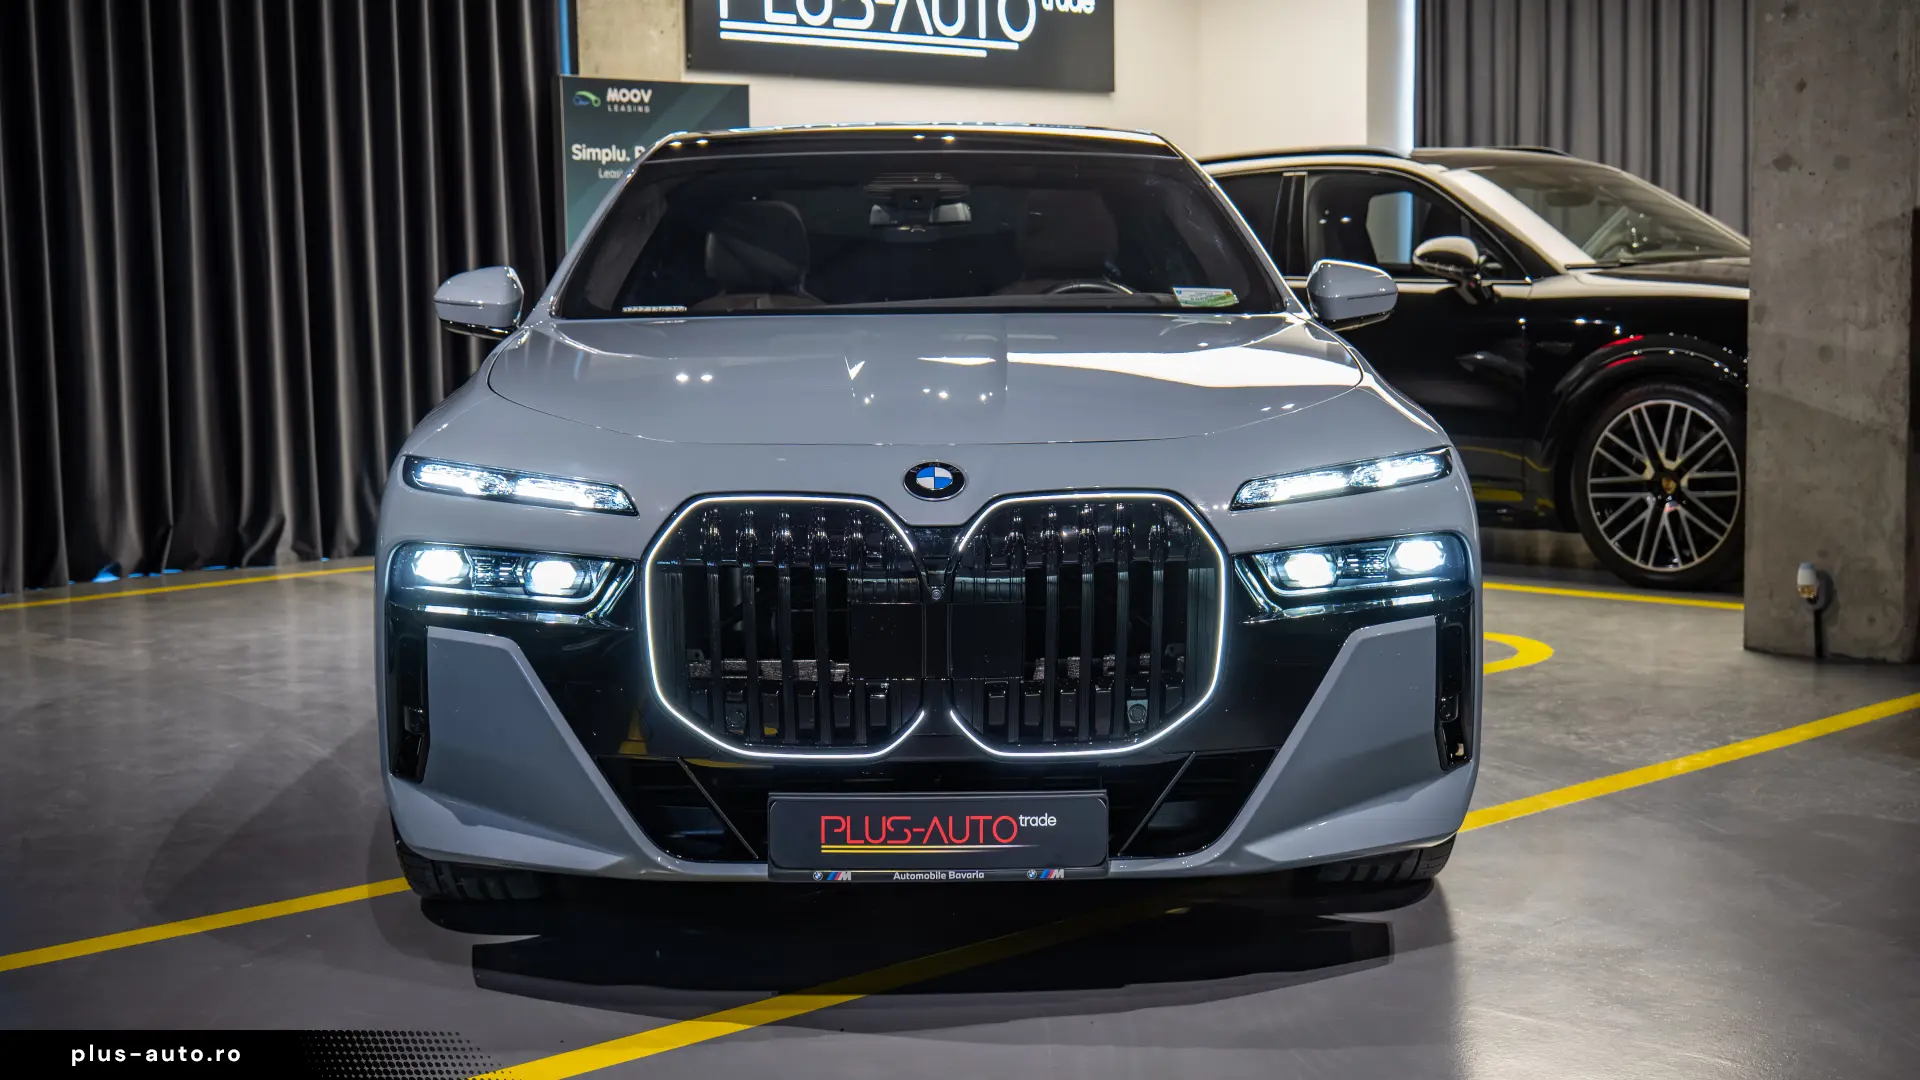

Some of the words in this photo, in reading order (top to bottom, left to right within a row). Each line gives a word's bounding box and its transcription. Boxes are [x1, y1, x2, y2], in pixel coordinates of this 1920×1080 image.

[606, 87, 653, 104] MOOV
[607, 104, 651, 113] LEASING
[571, 144, 631, 165] Simplu.
[820, 815, 1018, 844] PLUS-AUTO
[1018, 813, 1057, 827] trade
[893, 871, 946, 880] Automobile
[948, 870, 985, 880] Bavaria
